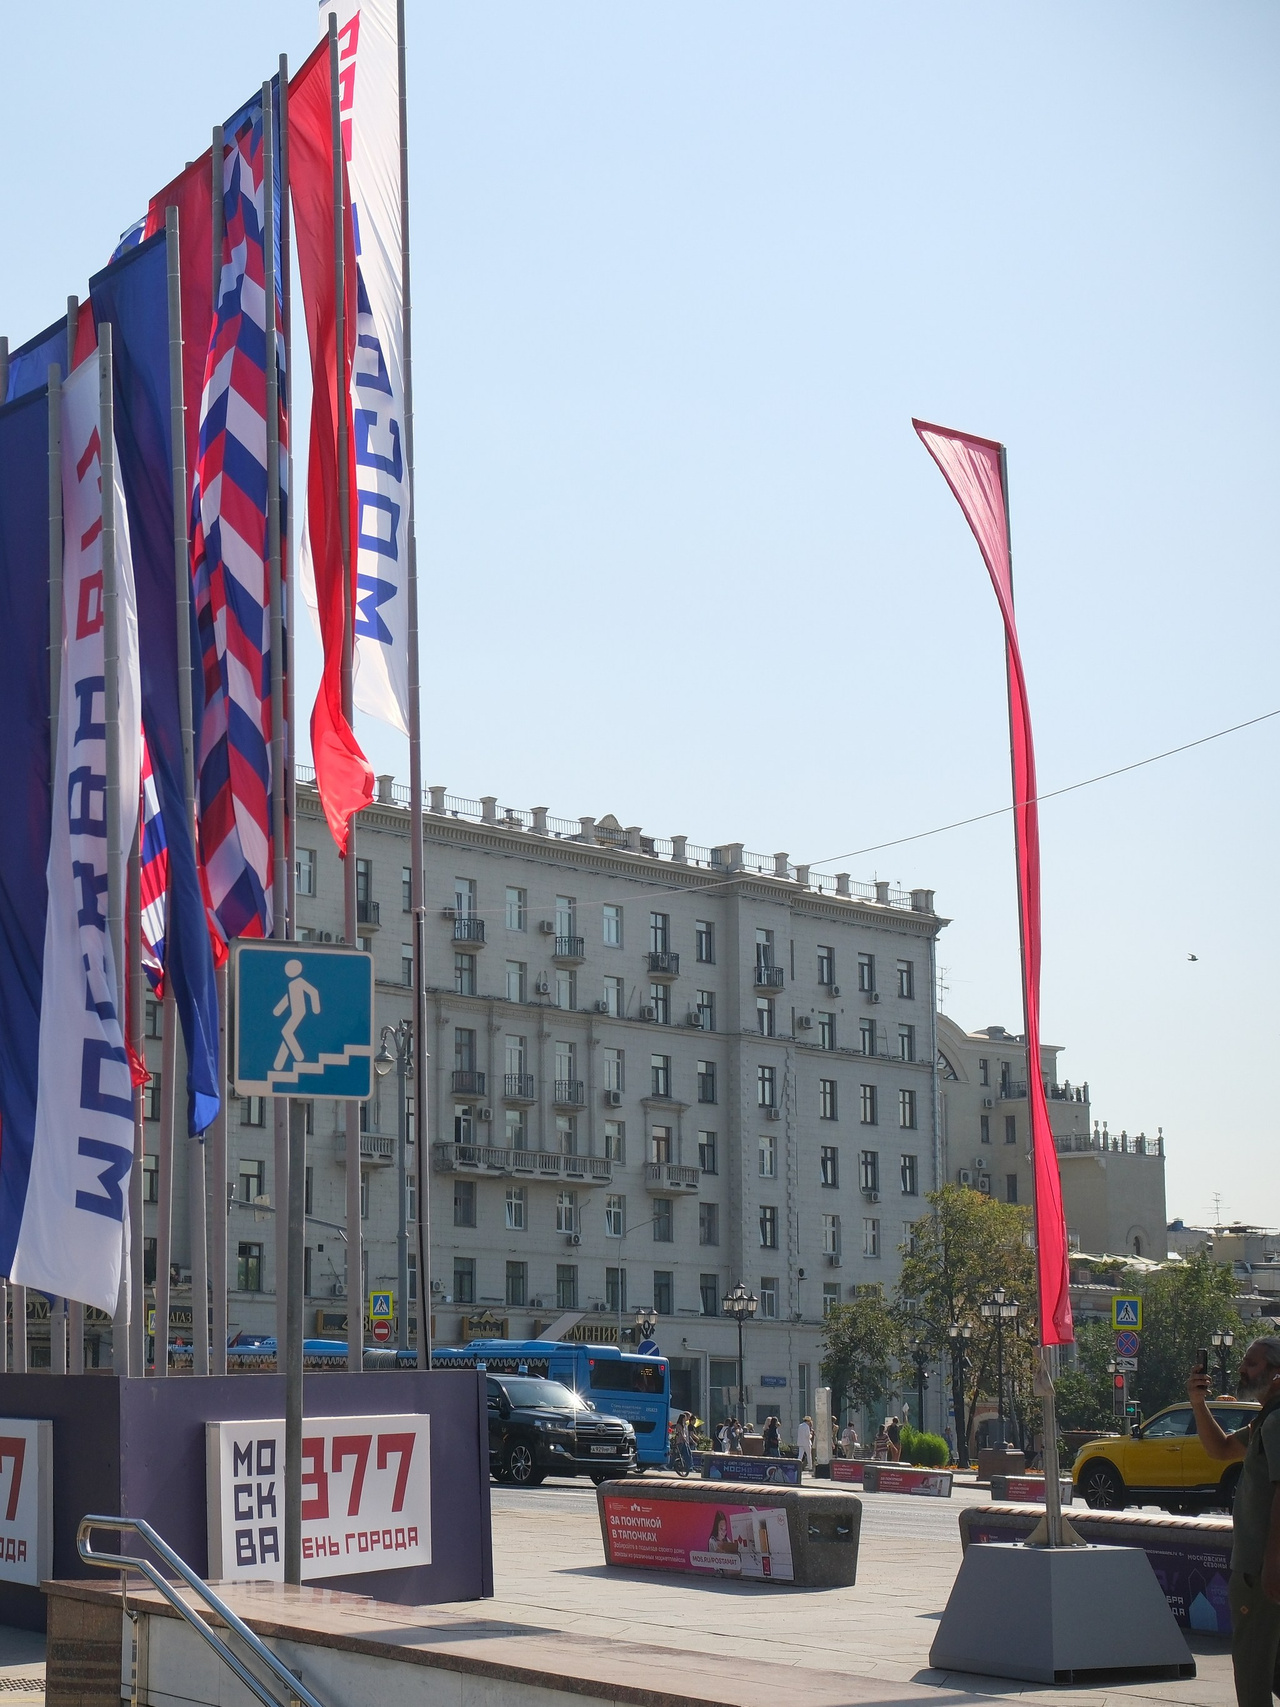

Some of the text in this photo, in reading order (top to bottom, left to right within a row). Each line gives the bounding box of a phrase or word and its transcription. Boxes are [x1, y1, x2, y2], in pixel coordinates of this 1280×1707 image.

[563, 1325, 619, 1342] РМЕНИЯ
[233, 1439, 277, 1478] МО
[233, 1481, 277, 1521] СК
[610, 1515, 662, 1529] ЗА ПОКУПКОЙ
[301, 1526, 419, 1559] ЕНЬ ГОРОДА
[612, 1529, 657, 1542] В ТАПОЧКАХ
[235, 1526, 280, 1567] ВА
[1187, 1554, 1227, 1563] МОСКОВСКИЕ
[1202, 1561, 1228, 1569] СЕЗОНЫ
